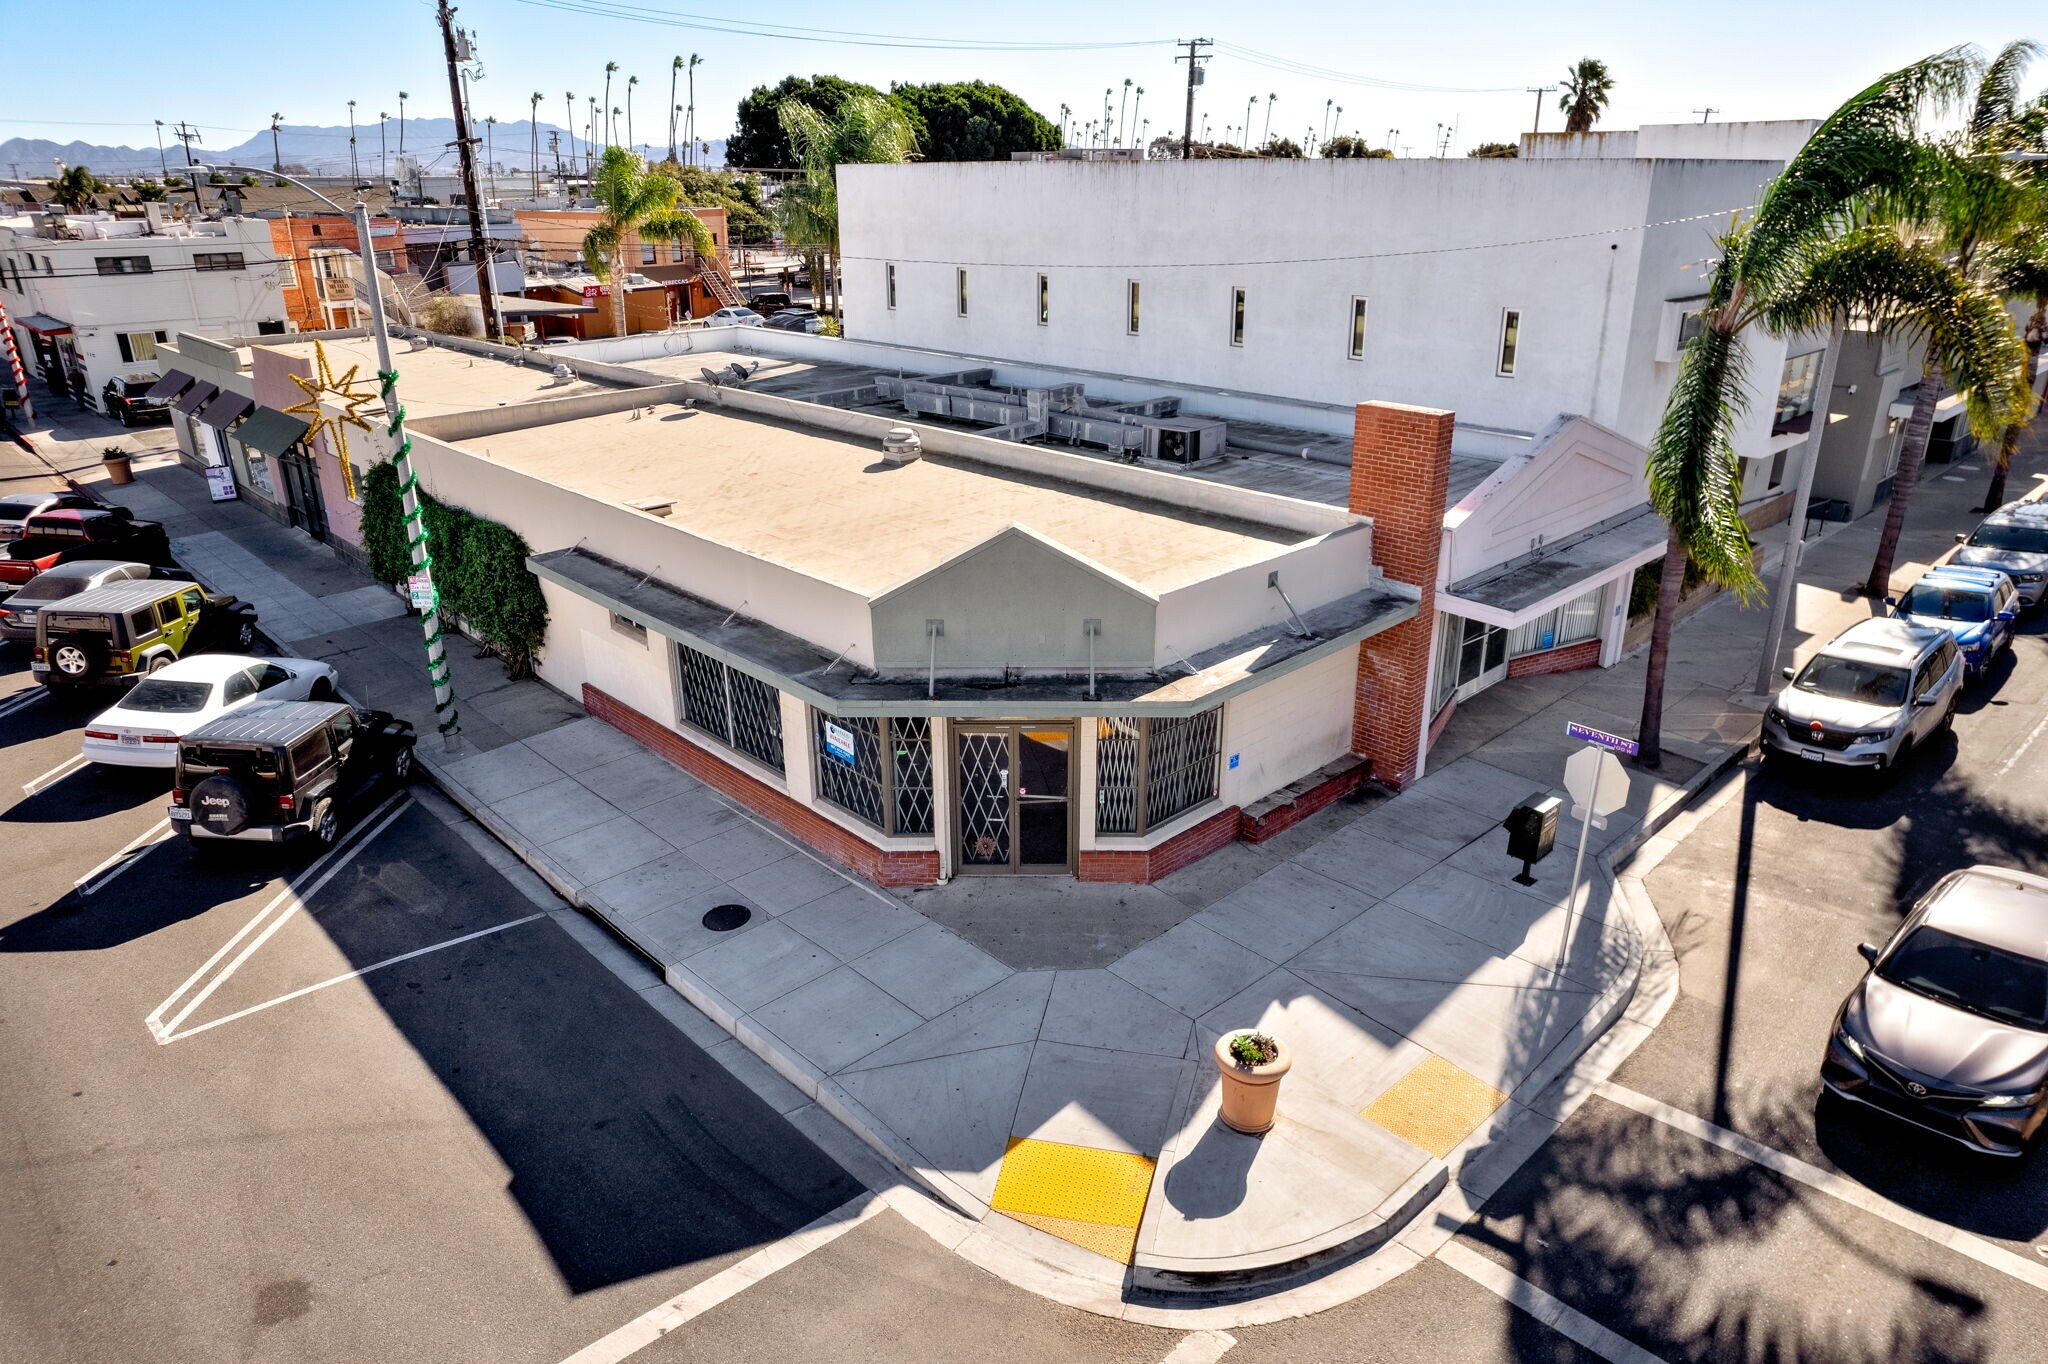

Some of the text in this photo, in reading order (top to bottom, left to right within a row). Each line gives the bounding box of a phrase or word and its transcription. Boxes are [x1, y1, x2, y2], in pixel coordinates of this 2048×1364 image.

[829, 734, 851, 749] AVAILABLE
[1571, 725, 1635, 749] SEVENTH ST
[201, 795, 230, 808] Jeep
